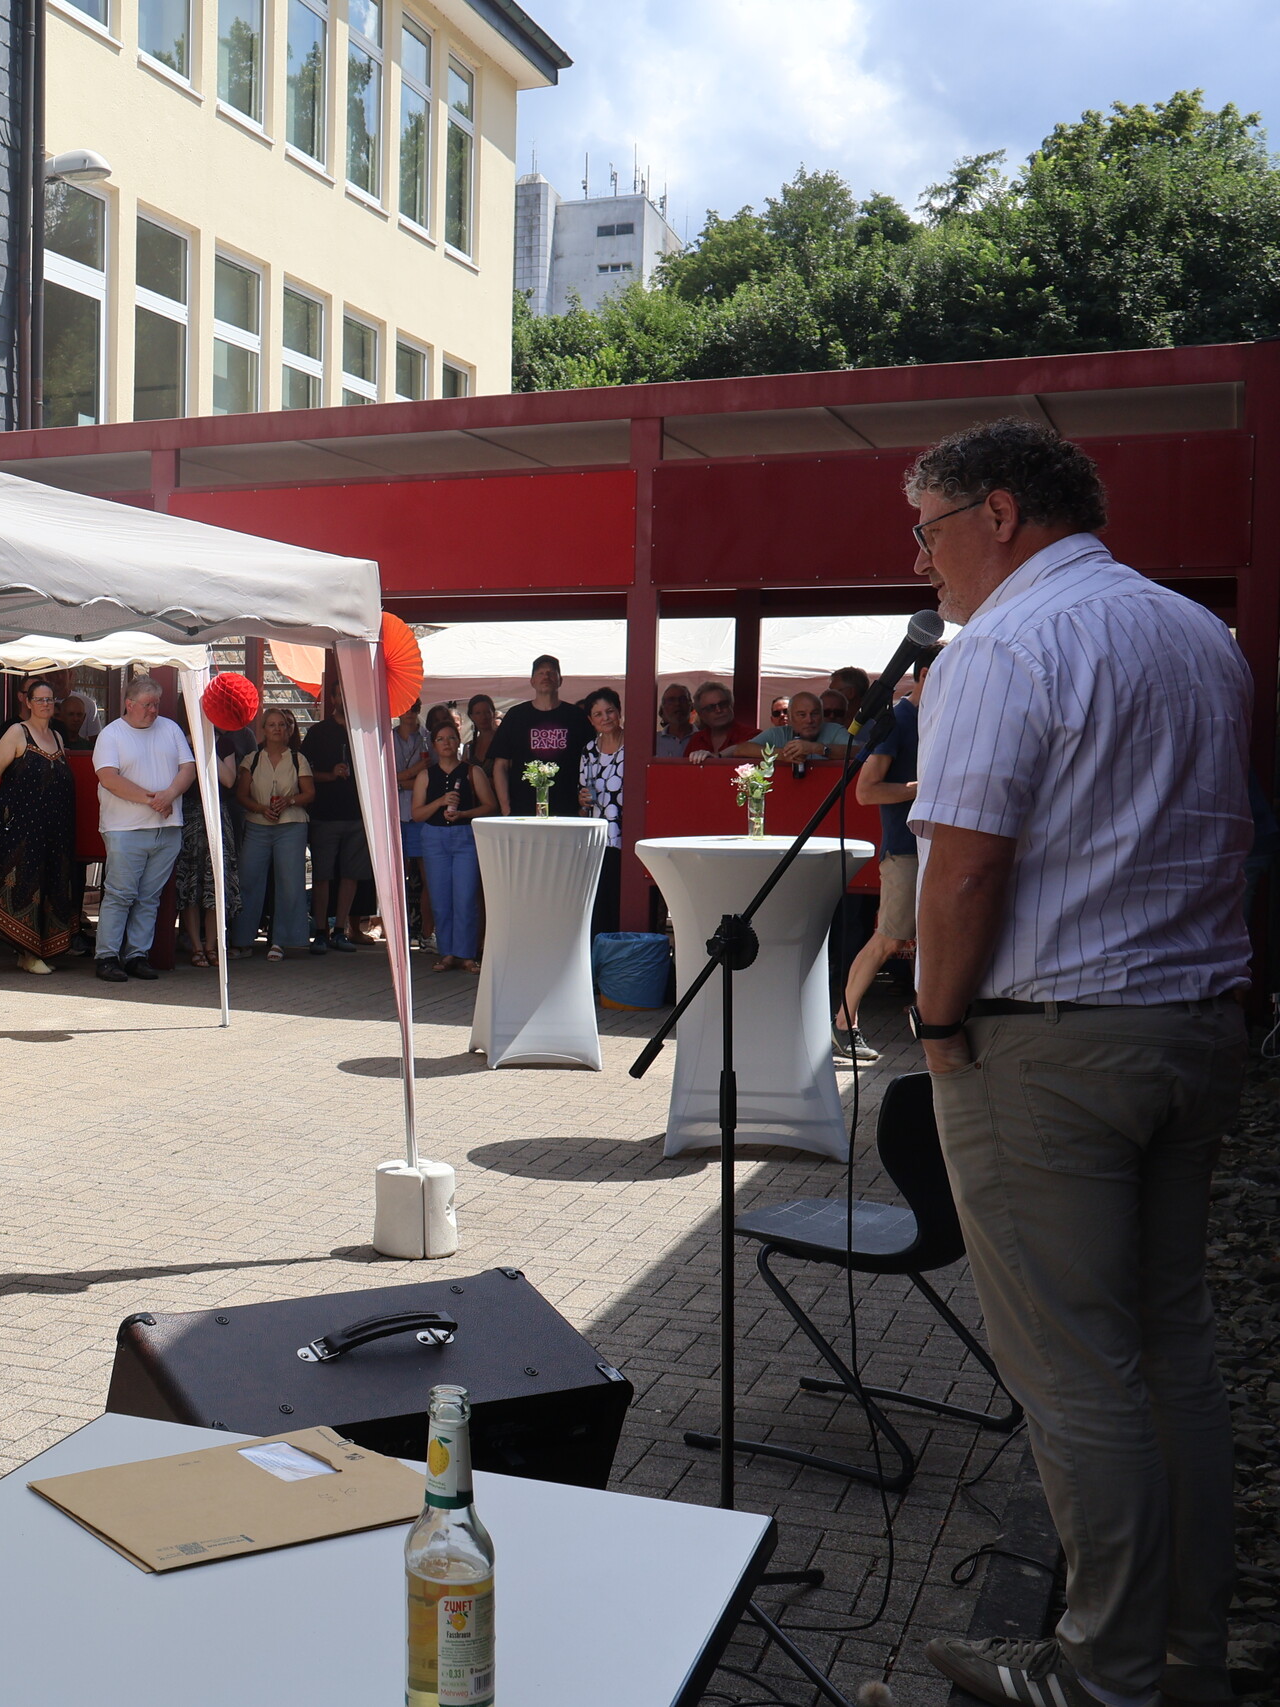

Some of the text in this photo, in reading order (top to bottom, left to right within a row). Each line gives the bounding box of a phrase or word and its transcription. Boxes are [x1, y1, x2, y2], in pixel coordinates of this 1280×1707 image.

[531, 728, 568, 739] DON'T
[531, 739, 567, 749] PANIC
[444, 1600, 473, 1612] ZUNFT
[440, 1688, 469, 1699] Mehrweg
